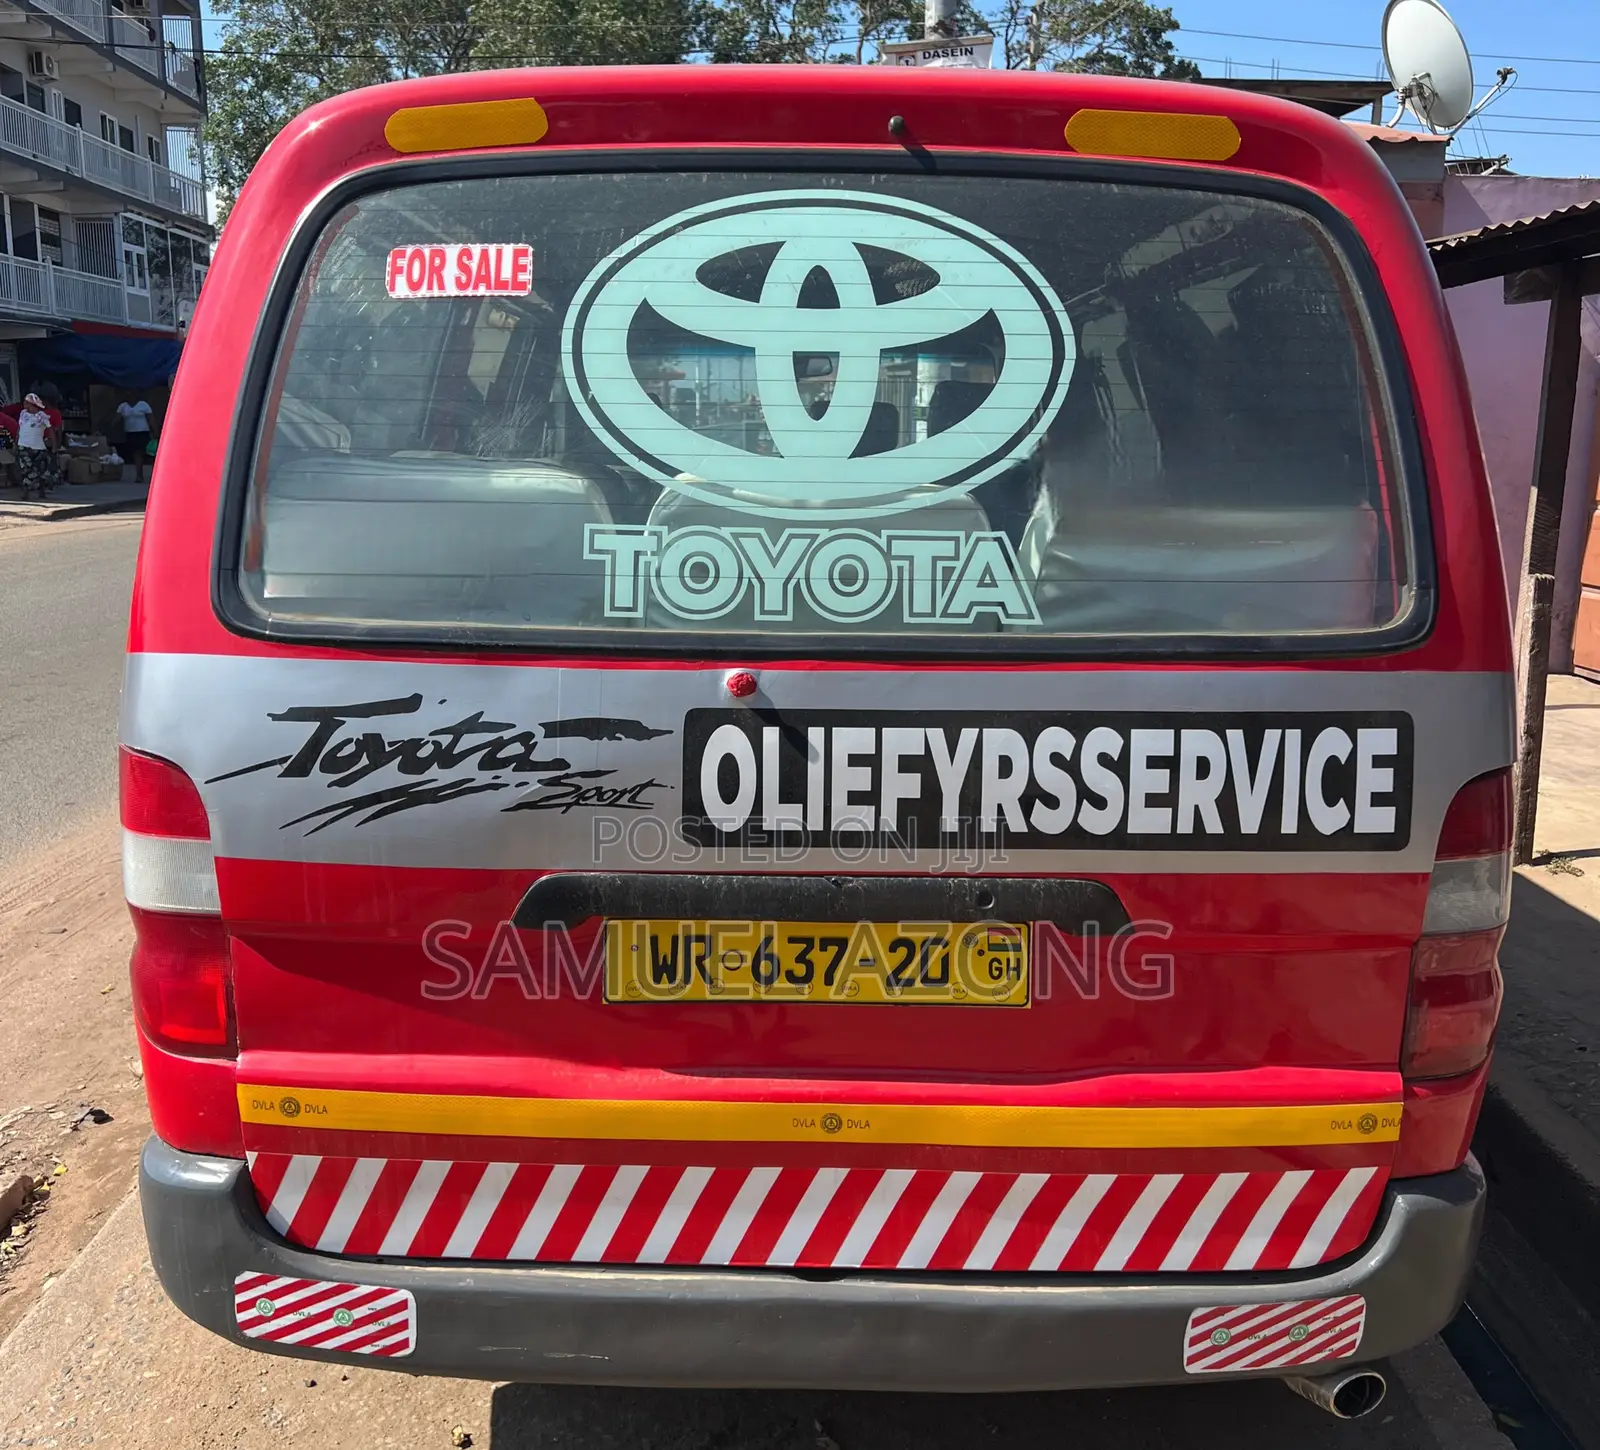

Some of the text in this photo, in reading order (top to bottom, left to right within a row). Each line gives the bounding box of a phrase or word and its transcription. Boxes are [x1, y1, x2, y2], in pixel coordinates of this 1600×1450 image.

[922, 47, 974, 60] DASEIN
[388, 246, 530, 292] FOR SALE
[583, 523, 1044, 625] TOYOTA
[204, 692, 571, 789] Toyota
[500, 768, 676, 815] Sport
[700, 724, 1398, 836] OLIEFYRSSERVICE
[650, 935, 950, 987] WR637-20
[988, 957, 1021, 981] GH
[252, 1099, 276, 1111] DVLA
[304, 1103, 328, 1115] DVLA
[792, 1117, 816, 1129] DVLA
[846, 1118, 871, 1130] DVLA
[1330, 1119, 1353, 1131] DVLA
